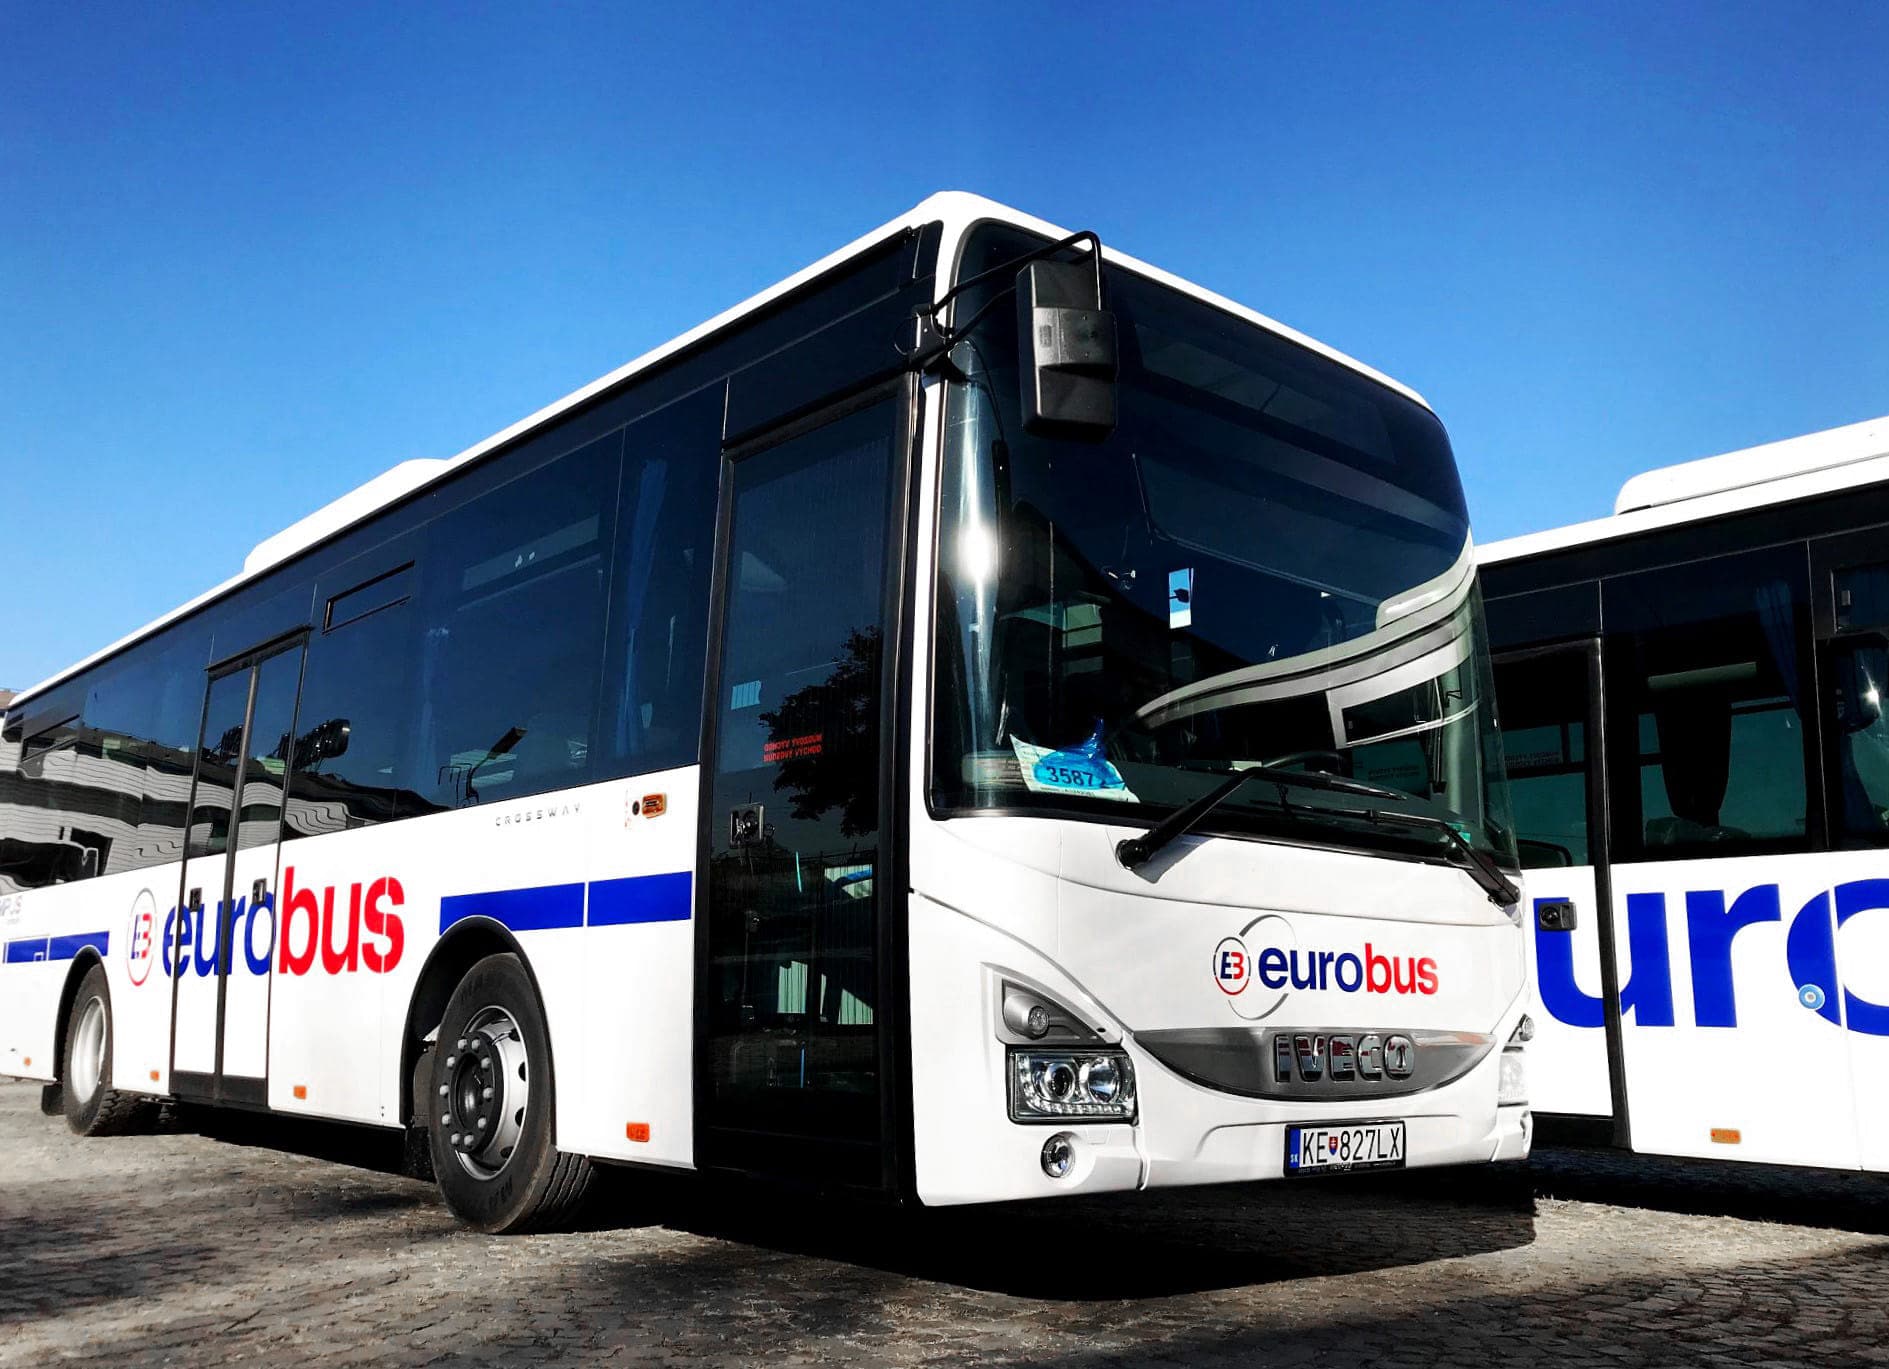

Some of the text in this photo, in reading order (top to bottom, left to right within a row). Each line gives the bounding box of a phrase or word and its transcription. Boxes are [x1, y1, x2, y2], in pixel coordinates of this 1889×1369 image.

[495, 803, 580, 827] CROSSWAY
[162, 866, 405, 978] eurobus
[1258, 943, 1440, 995] eurobus
[1274, 1034, 1416, 1083] IVECO
